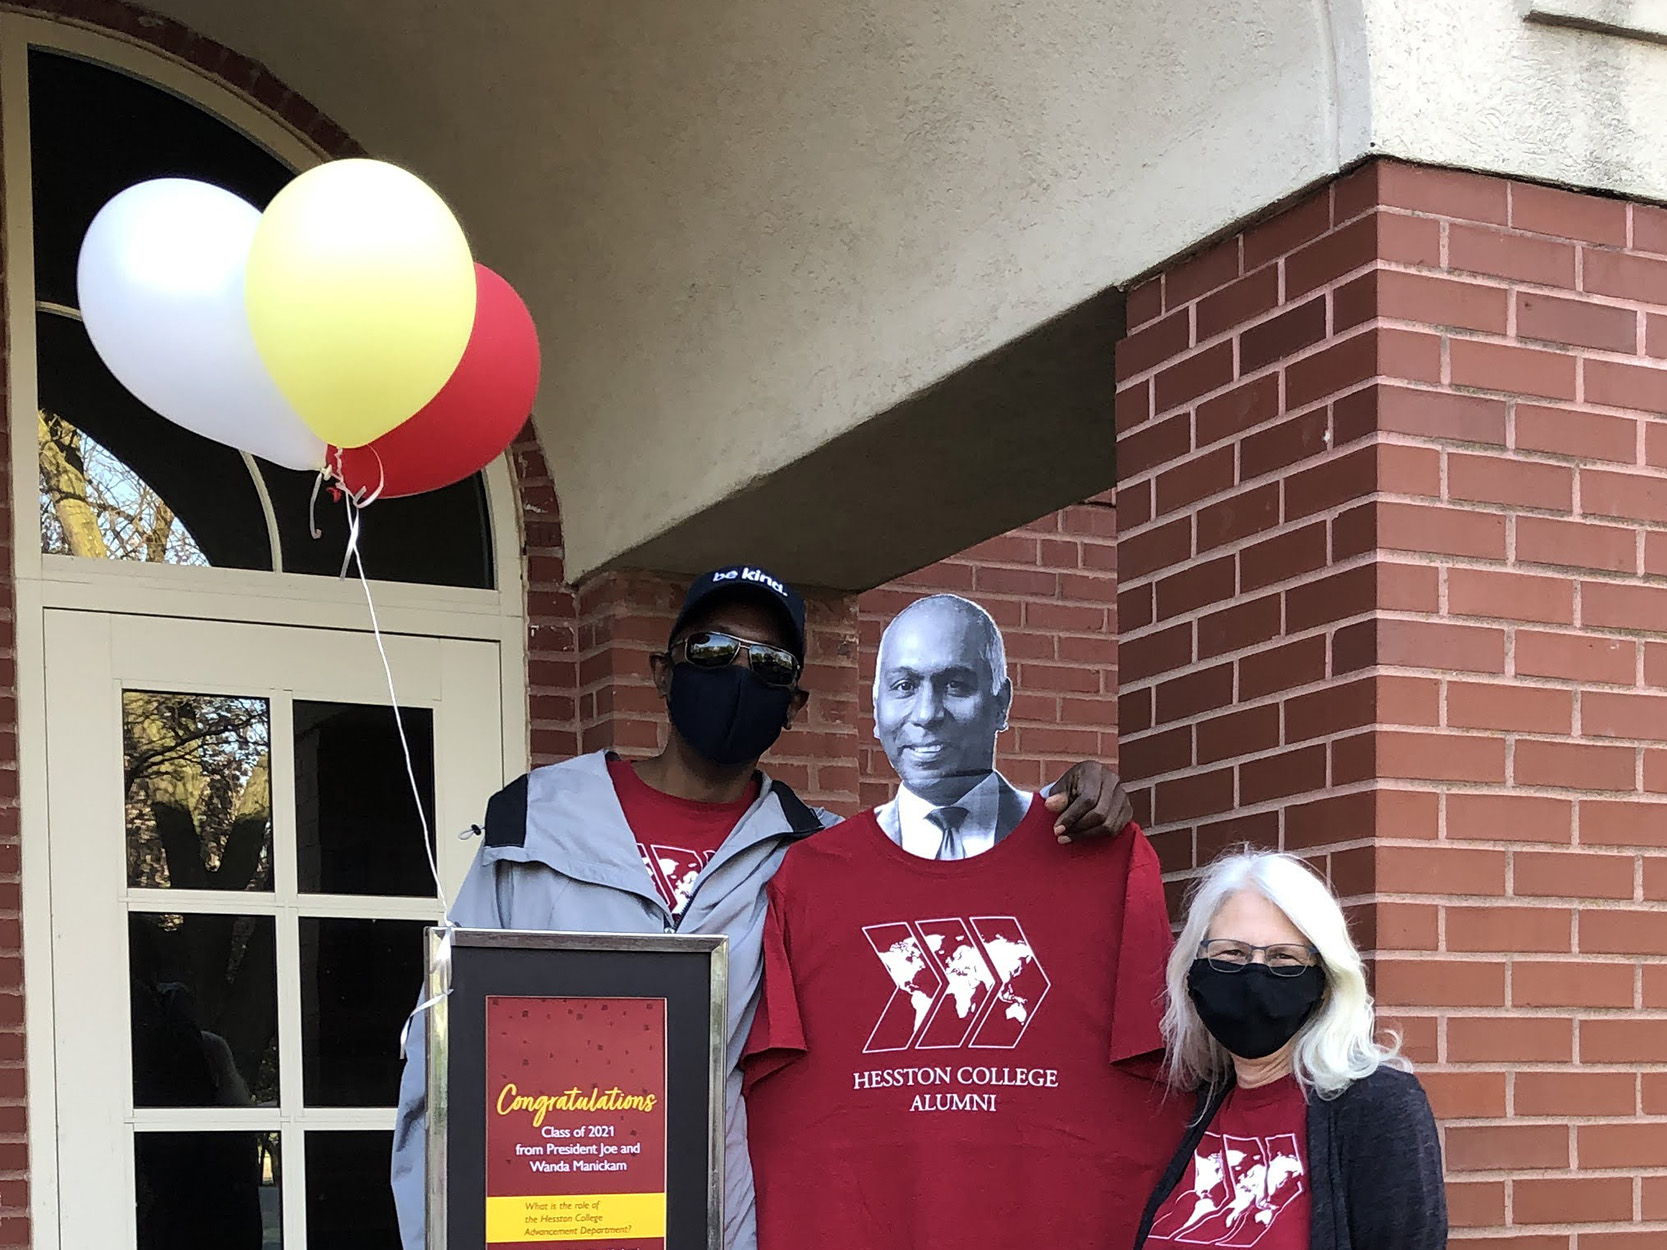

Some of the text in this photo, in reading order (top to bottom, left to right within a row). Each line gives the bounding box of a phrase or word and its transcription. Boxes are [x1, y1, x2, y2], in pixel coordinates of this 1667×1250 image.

[712, 569, 738, 582] be
[852, 1067, 1059, 1090] HESSTON COLLEGE
[496, 1083, 657, 1128] Congratulations
[909, 1093, 997, 1112] ALUMNI
[541, 1125, 615, 1138] Class of 2021
[515, 1143, 641, 1156] from President Joe and
[529, 1160, 627, 1172] Wanda Manickam
[525, 1200, 601, 1211] What is the role of
[524, 1213, 603, 1224] the Hesston College
[524, 1224, 632, 1236] Advancement Department?
